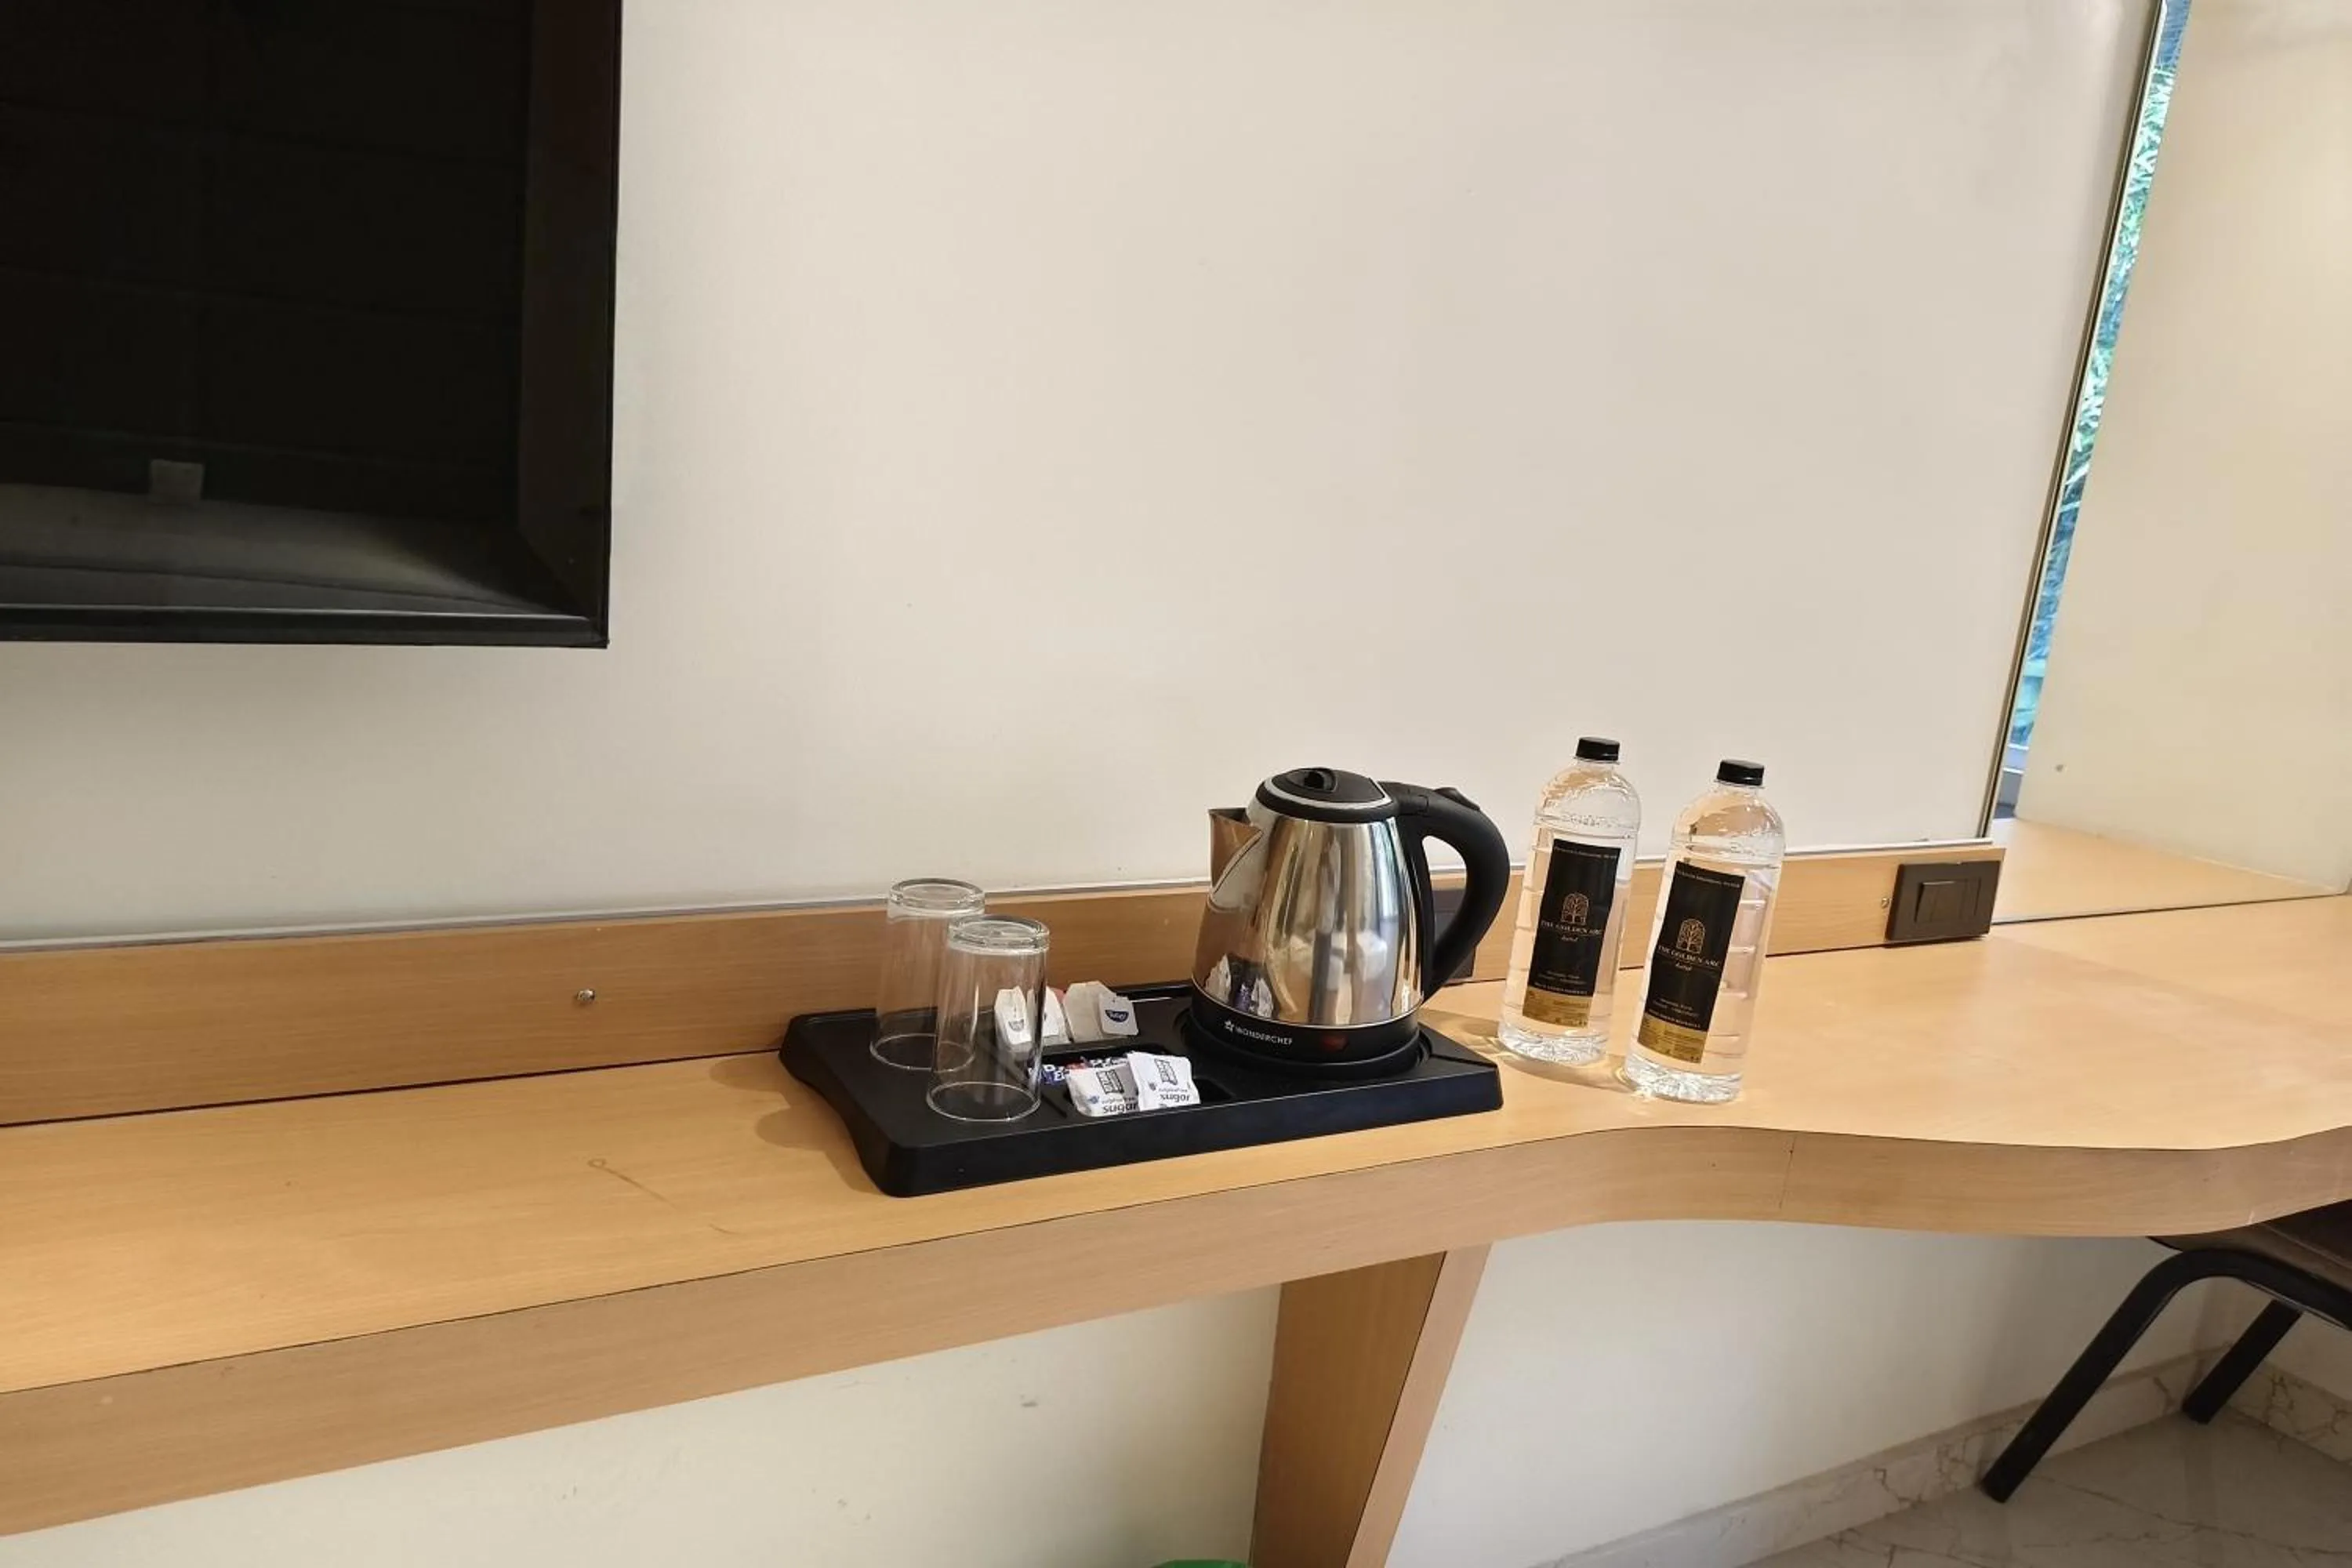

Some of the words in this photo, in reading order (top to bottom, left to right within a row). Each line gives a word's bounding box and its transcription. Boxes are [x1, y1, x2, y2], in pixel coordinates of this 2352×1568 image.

[1236, 1025, 1293, 1046] WONDERCHEF
[1159, 1093, 1191, 1104] sugar
[1103, 1102, 1137, 1113] sugar
